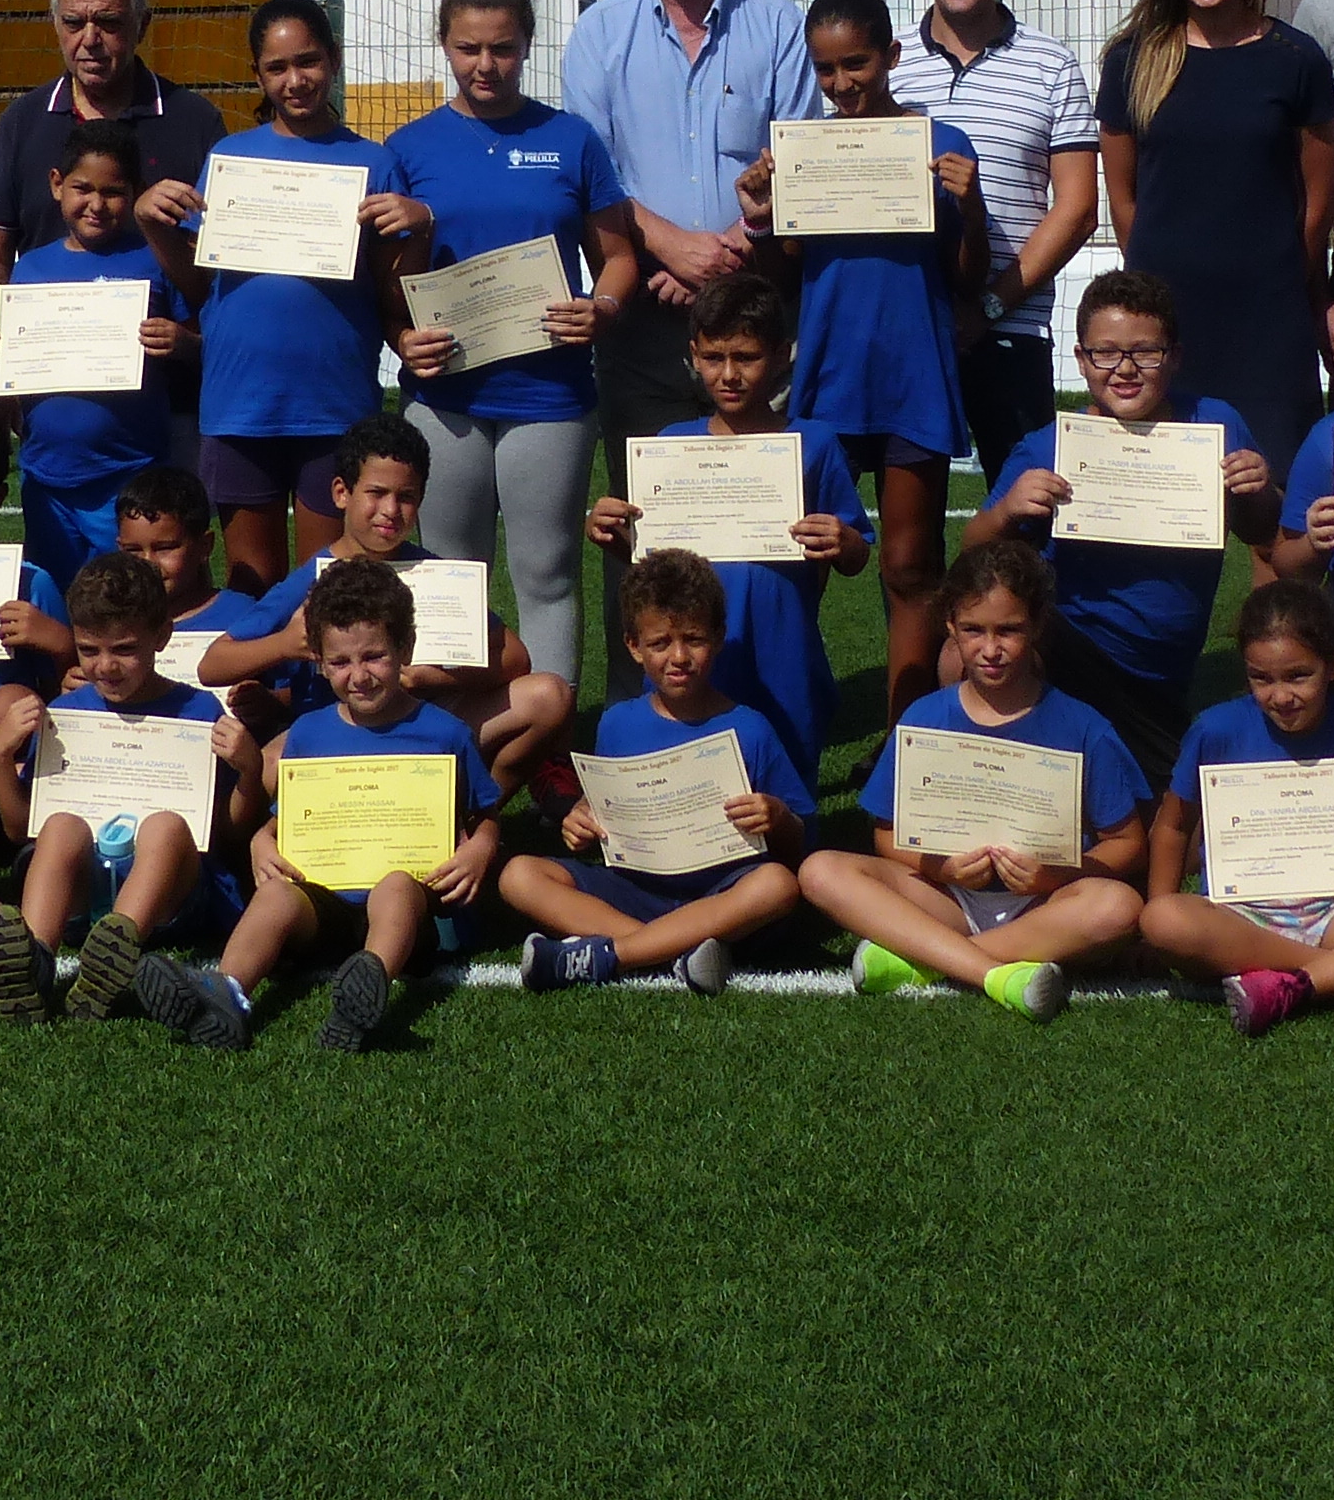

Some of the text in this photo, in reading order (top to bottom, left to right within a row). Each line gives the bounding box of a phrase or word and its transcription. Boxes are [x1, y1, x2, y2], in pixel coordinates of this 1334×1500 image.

[1122, 446, 1150, 454] DIPLOMA
[111, 741, 143, 750] DIPLOMA
[972, 760, 1005, 772] DIPLOMA
[635, 777, 668, 788] DIPLOMA
[1279, 789, 1313, 797] DIPLOMA
